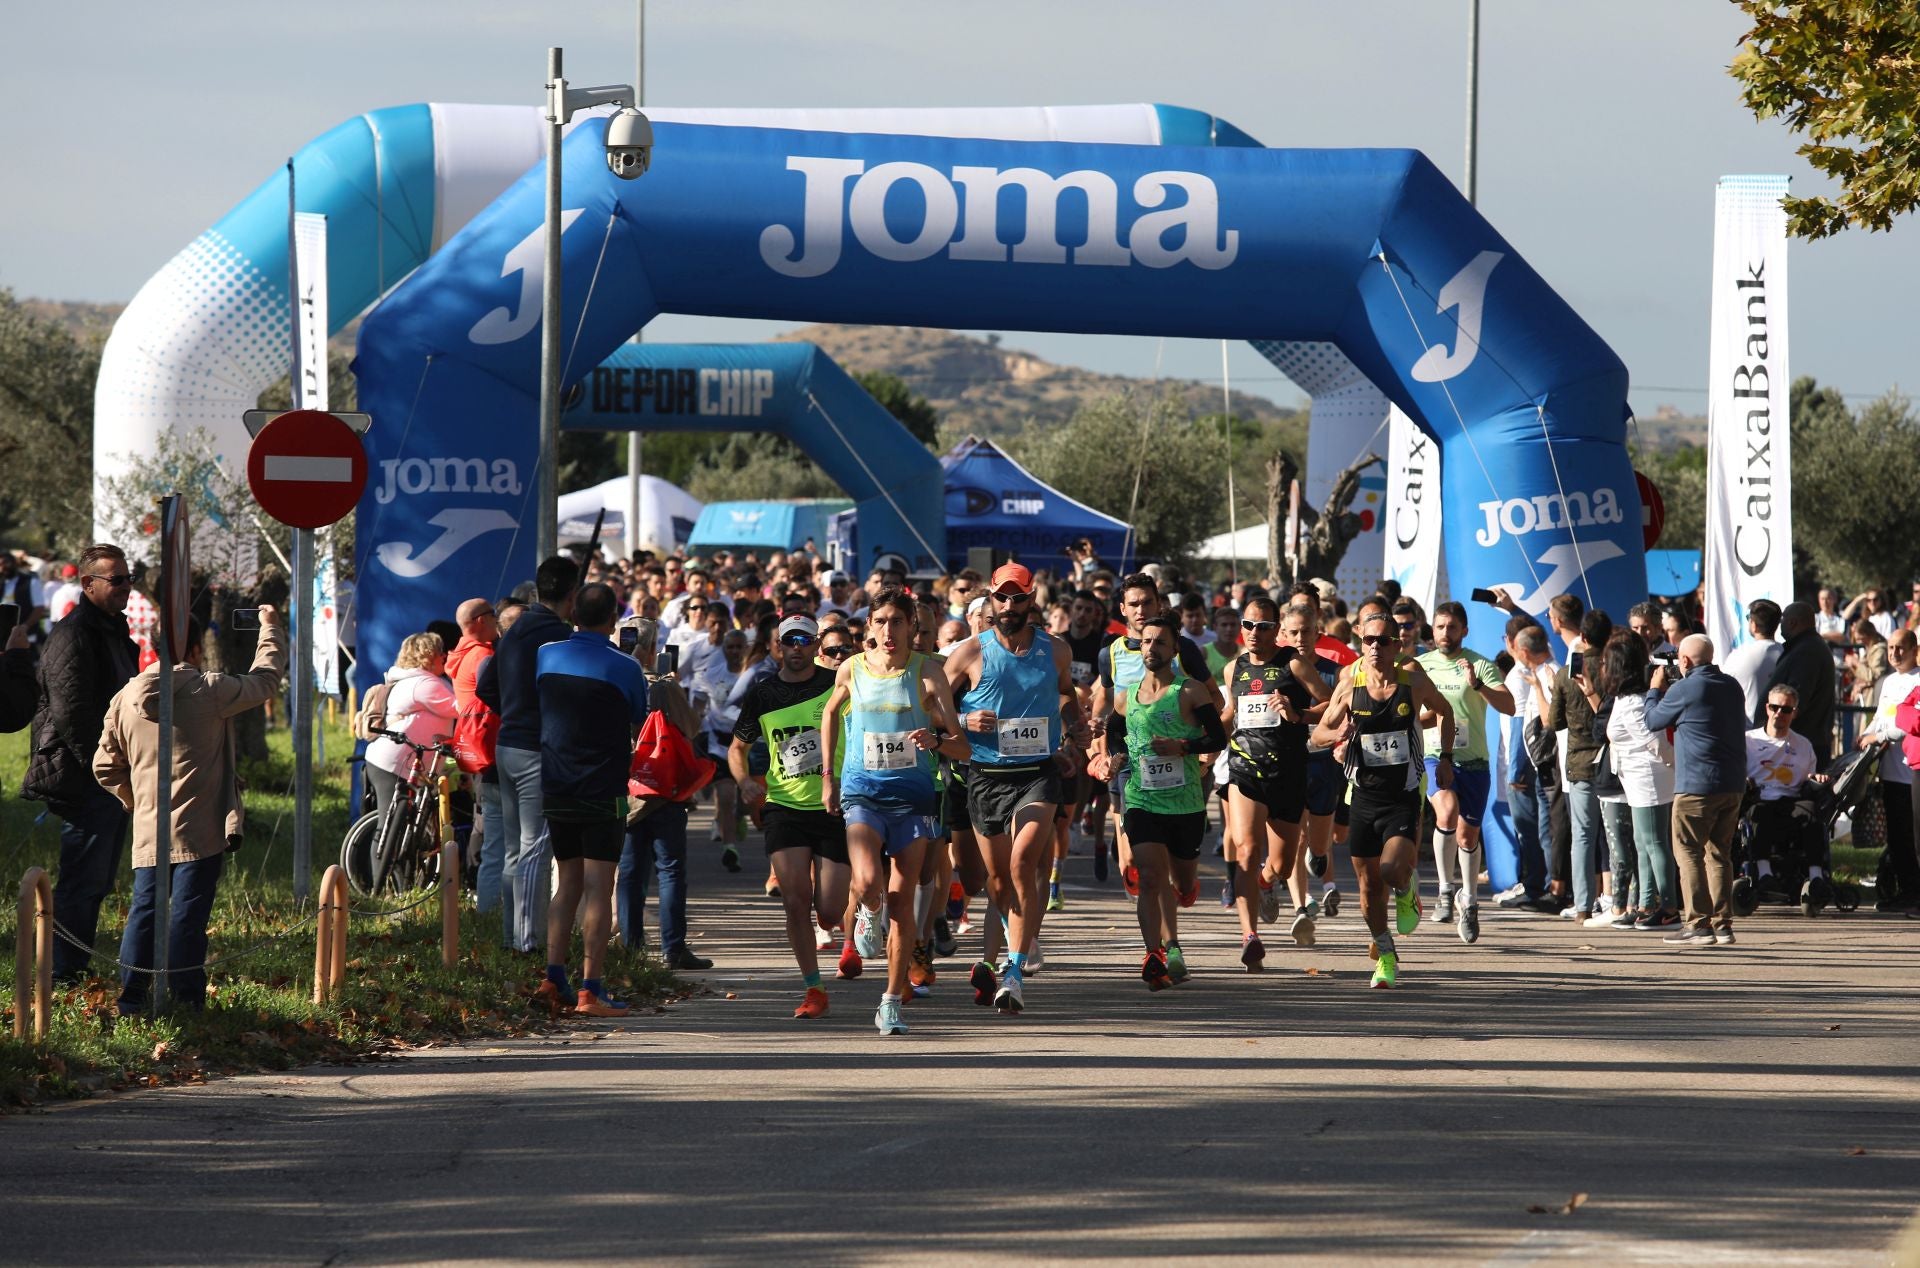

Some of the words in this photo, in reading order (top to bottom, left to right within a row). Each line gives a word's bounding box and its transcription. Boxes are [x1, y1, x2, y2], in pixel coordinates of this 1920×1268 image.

[1733, 257, 1772, 577] CaixaBank
[1002, 499, 1045, 515] CHIP
[1247, 703, 1268, 713] 257
[1011, 727, 1039, 740] 140
[790, 739, 818, 757] 333
[876, 741, 905, 754] 194
[1373, 740, 1399, 752] 314
[1148, 762, 1173, 775] 376
